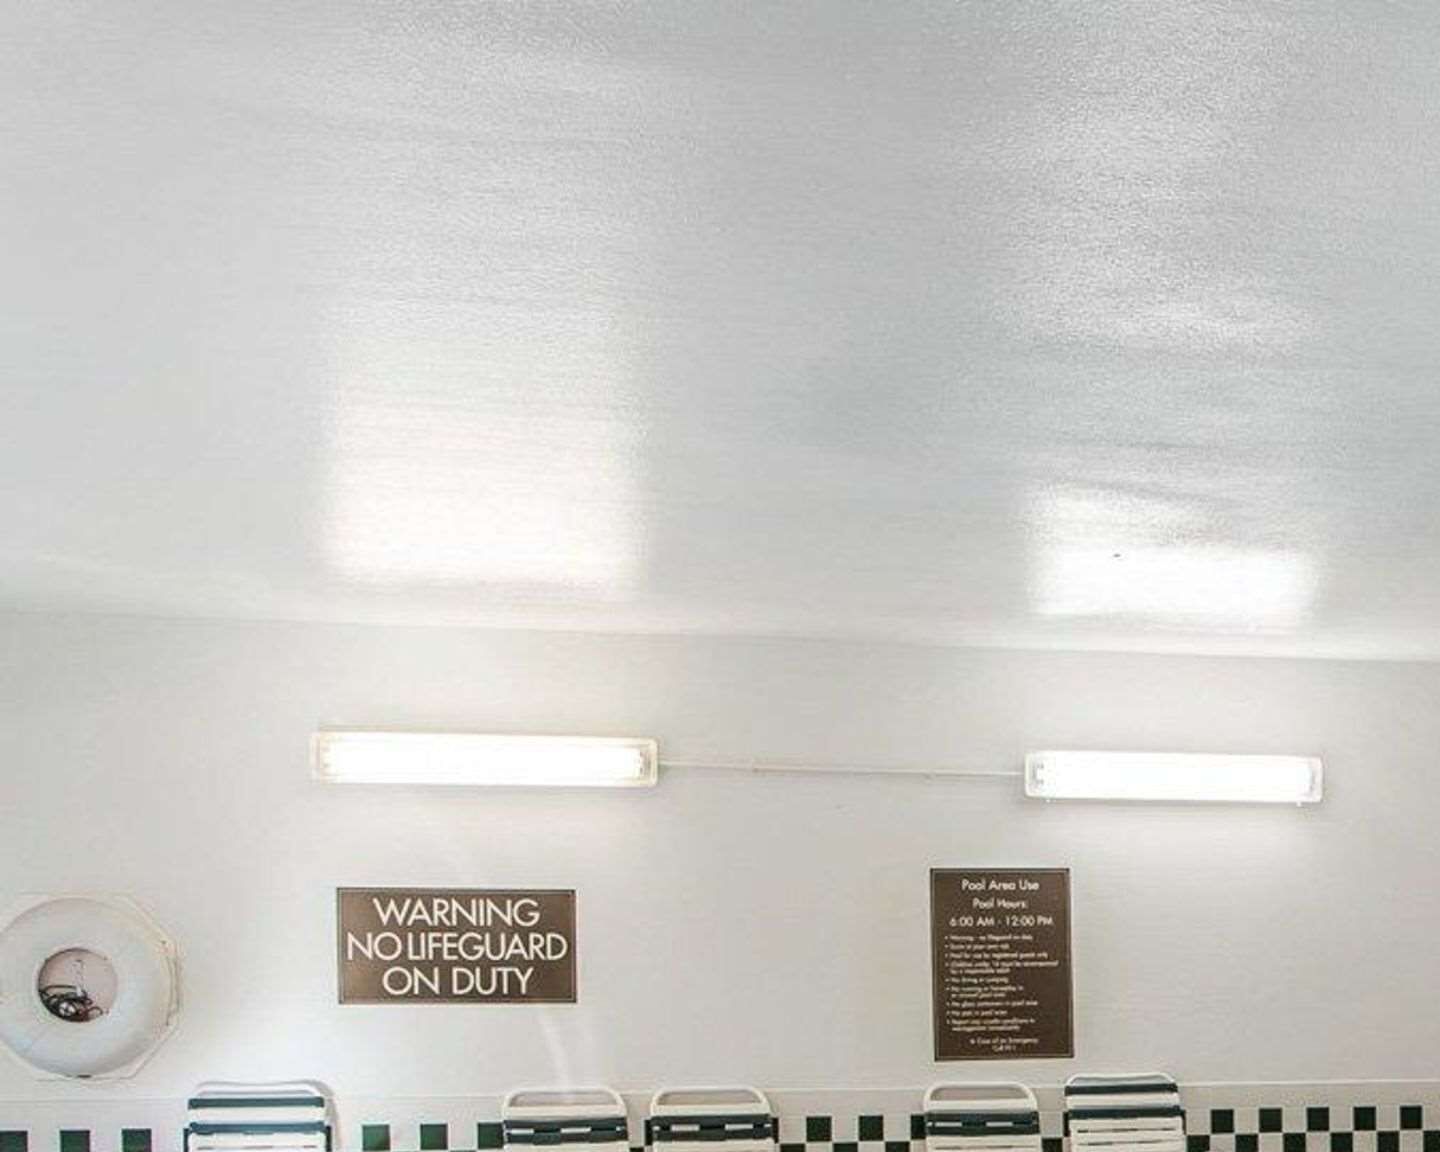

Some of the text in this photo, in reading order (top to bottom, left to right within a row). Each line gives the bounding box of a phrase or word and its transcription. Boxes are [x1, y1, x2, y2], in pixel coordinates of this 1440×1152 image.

[961, 879, 1039, 891] Pool Area Use
[372, 897, 541, 927] WARNING
[976, 917, 995, 927] AM
[1037, 916, 1054, 926] PM
[347, 931, 569, 961] NO LIFEGUARD
[382, 966, 534, 995] ON DUTY
